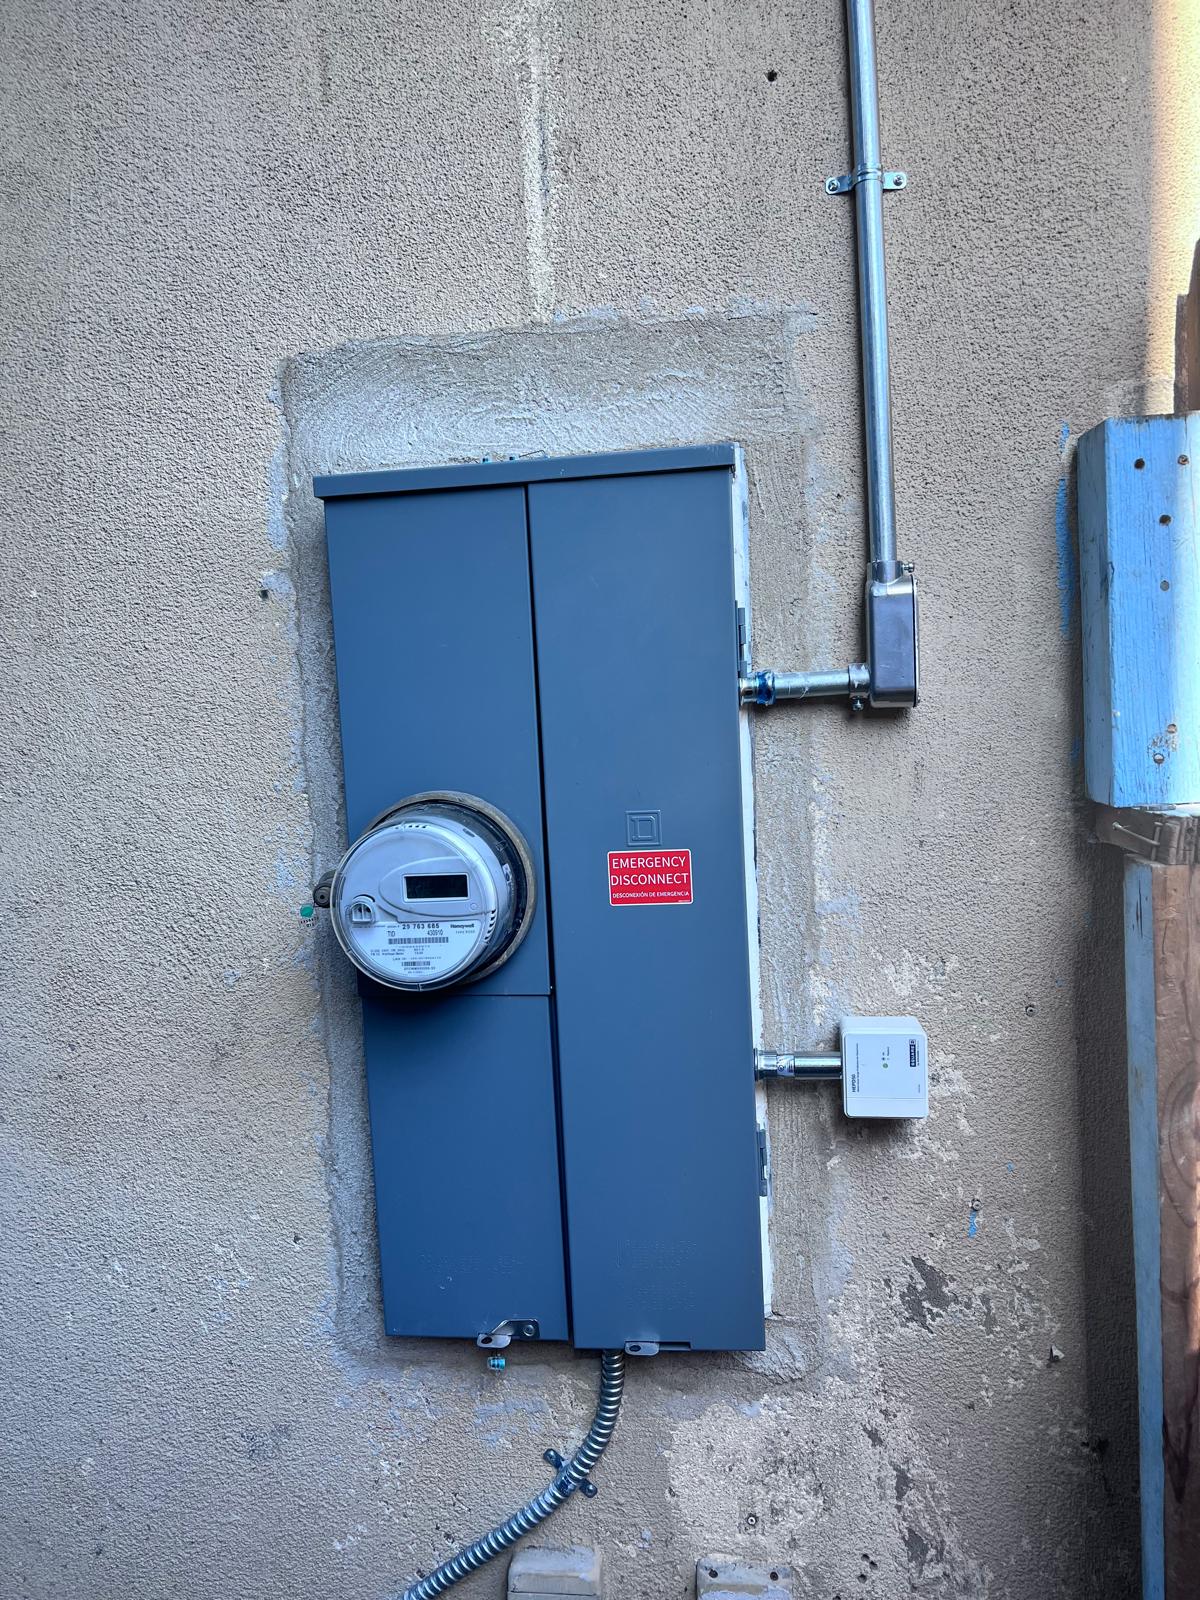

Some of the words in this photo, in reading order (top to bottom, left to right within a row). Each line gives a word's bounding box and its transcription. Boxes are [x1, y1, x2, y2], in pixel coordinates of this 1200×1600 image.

[612, 856, 686, 869] EMERGENCY
[611, 872, 689, 886] DISCONNECT
[612, 890, 648, 899] DESCONEXIÓN
